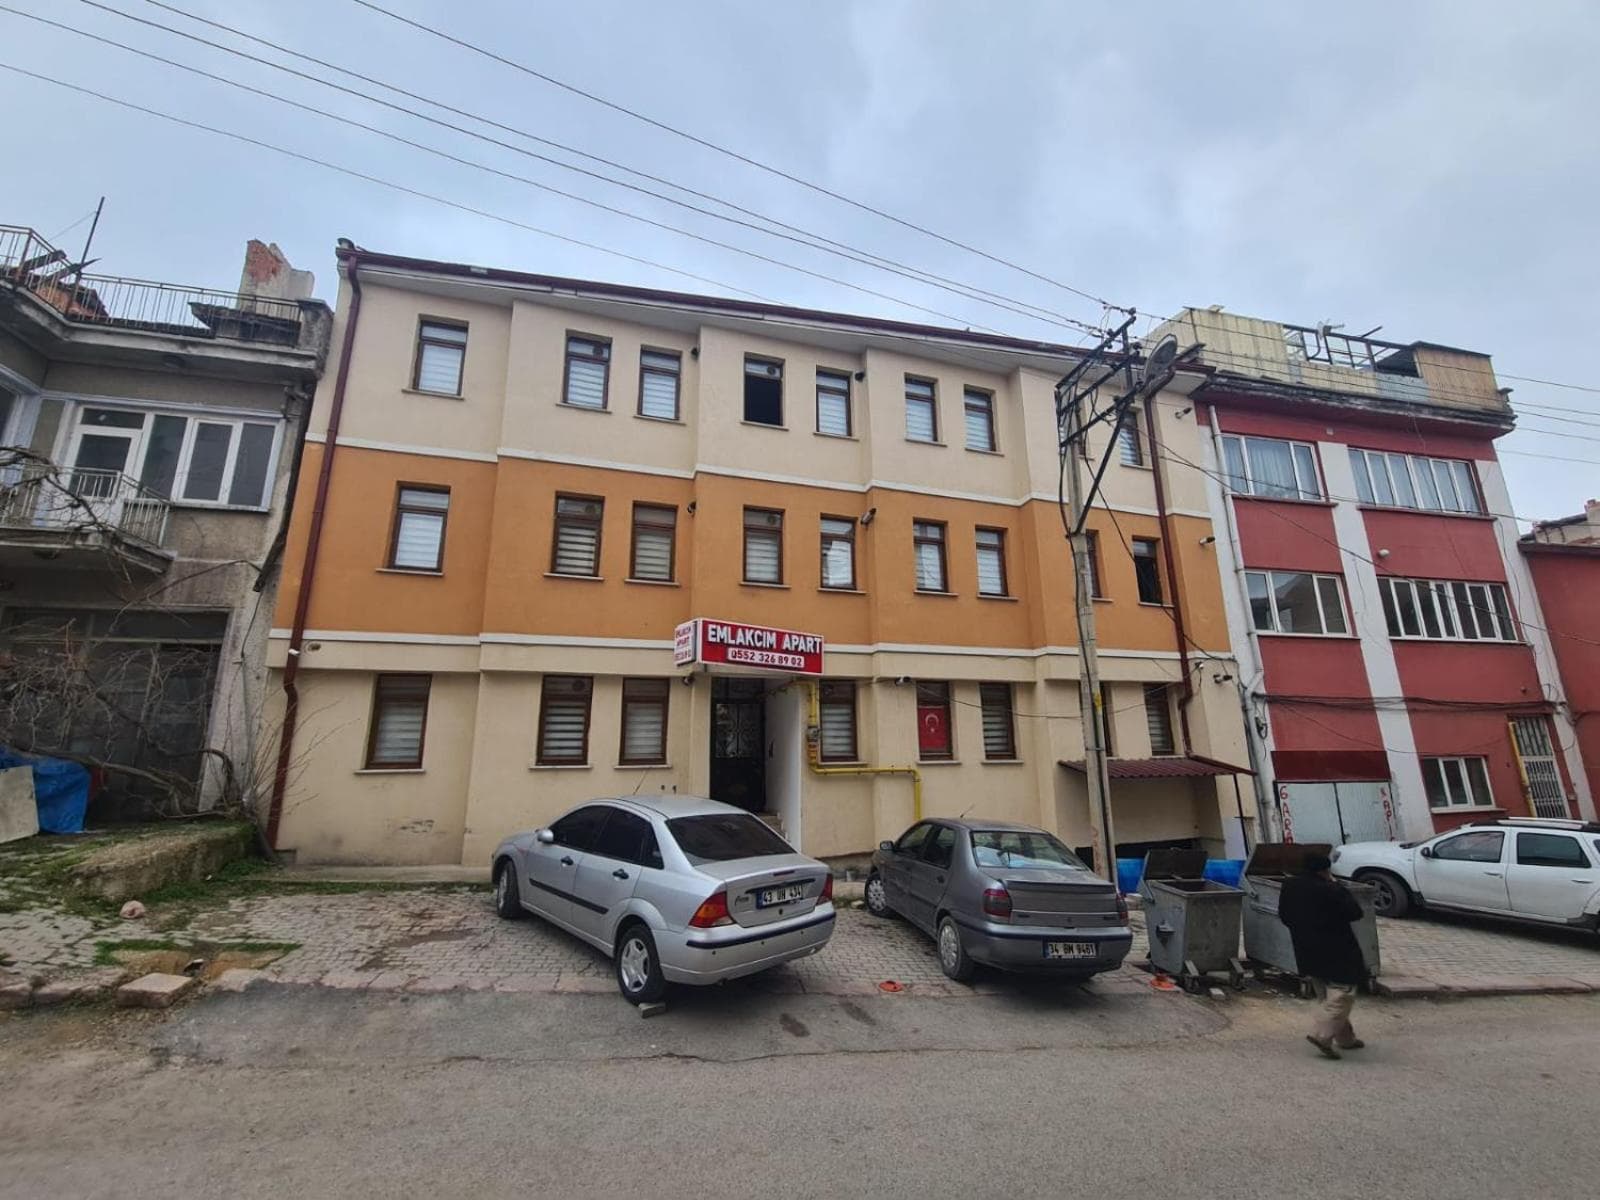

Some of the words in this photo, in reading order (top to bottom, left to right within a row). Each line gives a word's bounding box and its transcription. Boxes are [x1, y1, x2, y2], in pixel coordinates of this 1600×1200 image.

[707, 624, 777, 649] EMLAKCIM
[783, 636, 822, 654] APART
[731, 651, 756, 662] 0552
[759, 652, 776, 664] 326
[778, 655, 789, 666] 89
[791, 656, 803, 667] 02
[764, 891, 773, 903] 43
[1049, 943, 1060, 954] 34
